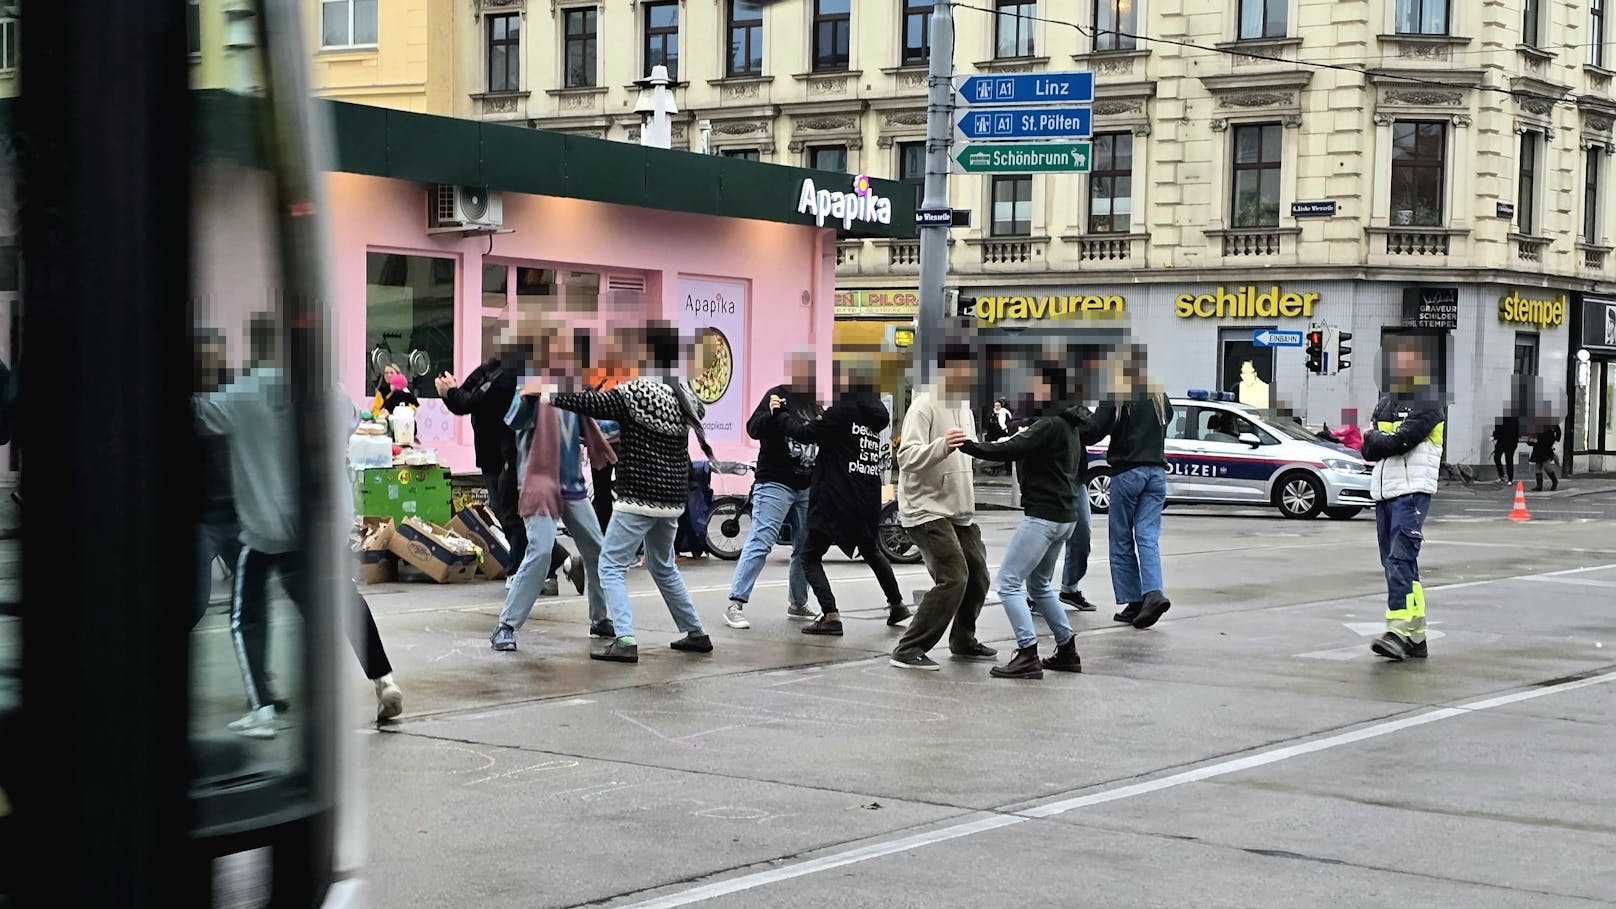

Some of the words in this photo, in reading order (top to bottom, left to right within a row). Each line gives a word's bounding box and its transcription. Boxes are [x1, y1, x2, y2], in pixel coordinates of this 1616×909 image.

[999, 82, 1012, 96] A1
[1035, 80, 1070, 96] Linz
[997, 117, 1010, 131] A1
[1021, 115, 1037, 131] St.
[1040, 114, 1080, 131] Pölten
[993, 150, 1069, 166] Schönbrunn
[798, 178, 891, 230] Apapika
[685, 293, 735, 318] Apapika
[976, 295, 1124, 323] gravuren
[1175, 286, 1319, 318] schilder
[1504, 290, 1566, 329] stempel
[1419, 320, 1457, 328] STEMPEL
[1270, 334, 1298, 343] EINBAHN
[859, 448, 869, 461] is
[1166, 462, 1216, 477] OLIZEI
